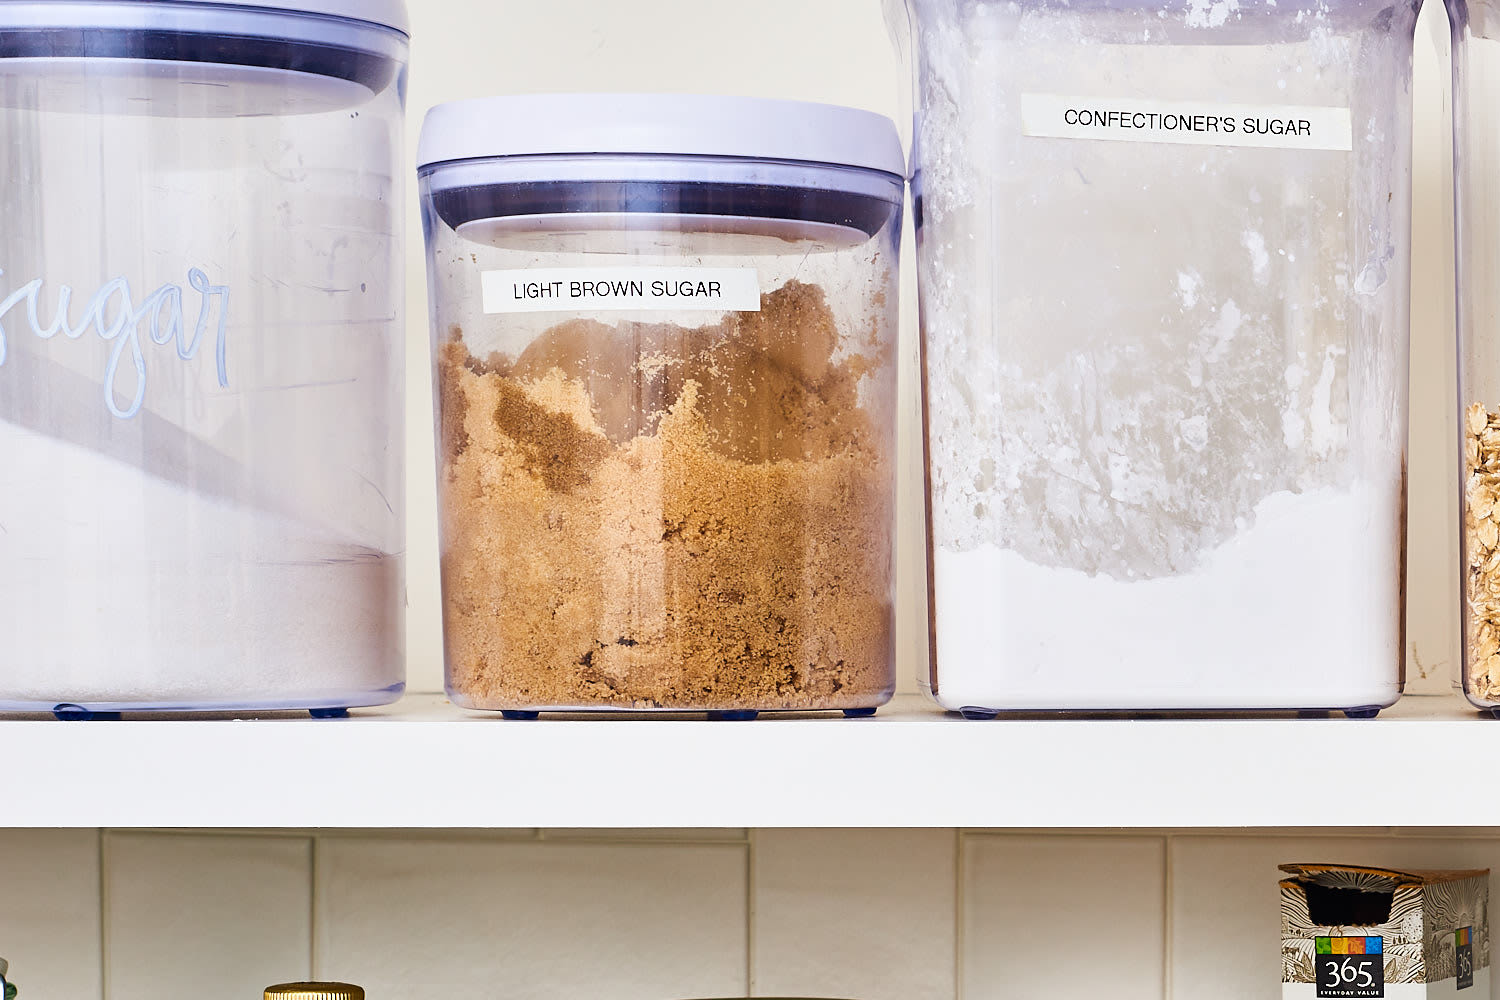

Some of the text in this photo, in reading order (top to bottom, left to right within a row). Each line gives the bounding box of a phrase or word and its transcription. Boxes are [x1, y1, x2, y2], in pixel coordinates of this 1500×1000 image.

[1063, 108, 1312, 136] CONFECTIONER'S SUGAR
[513, 280, 722, 299] LIGHT BROWN SUGAR
[1325, 956, 1374, 988] 365
